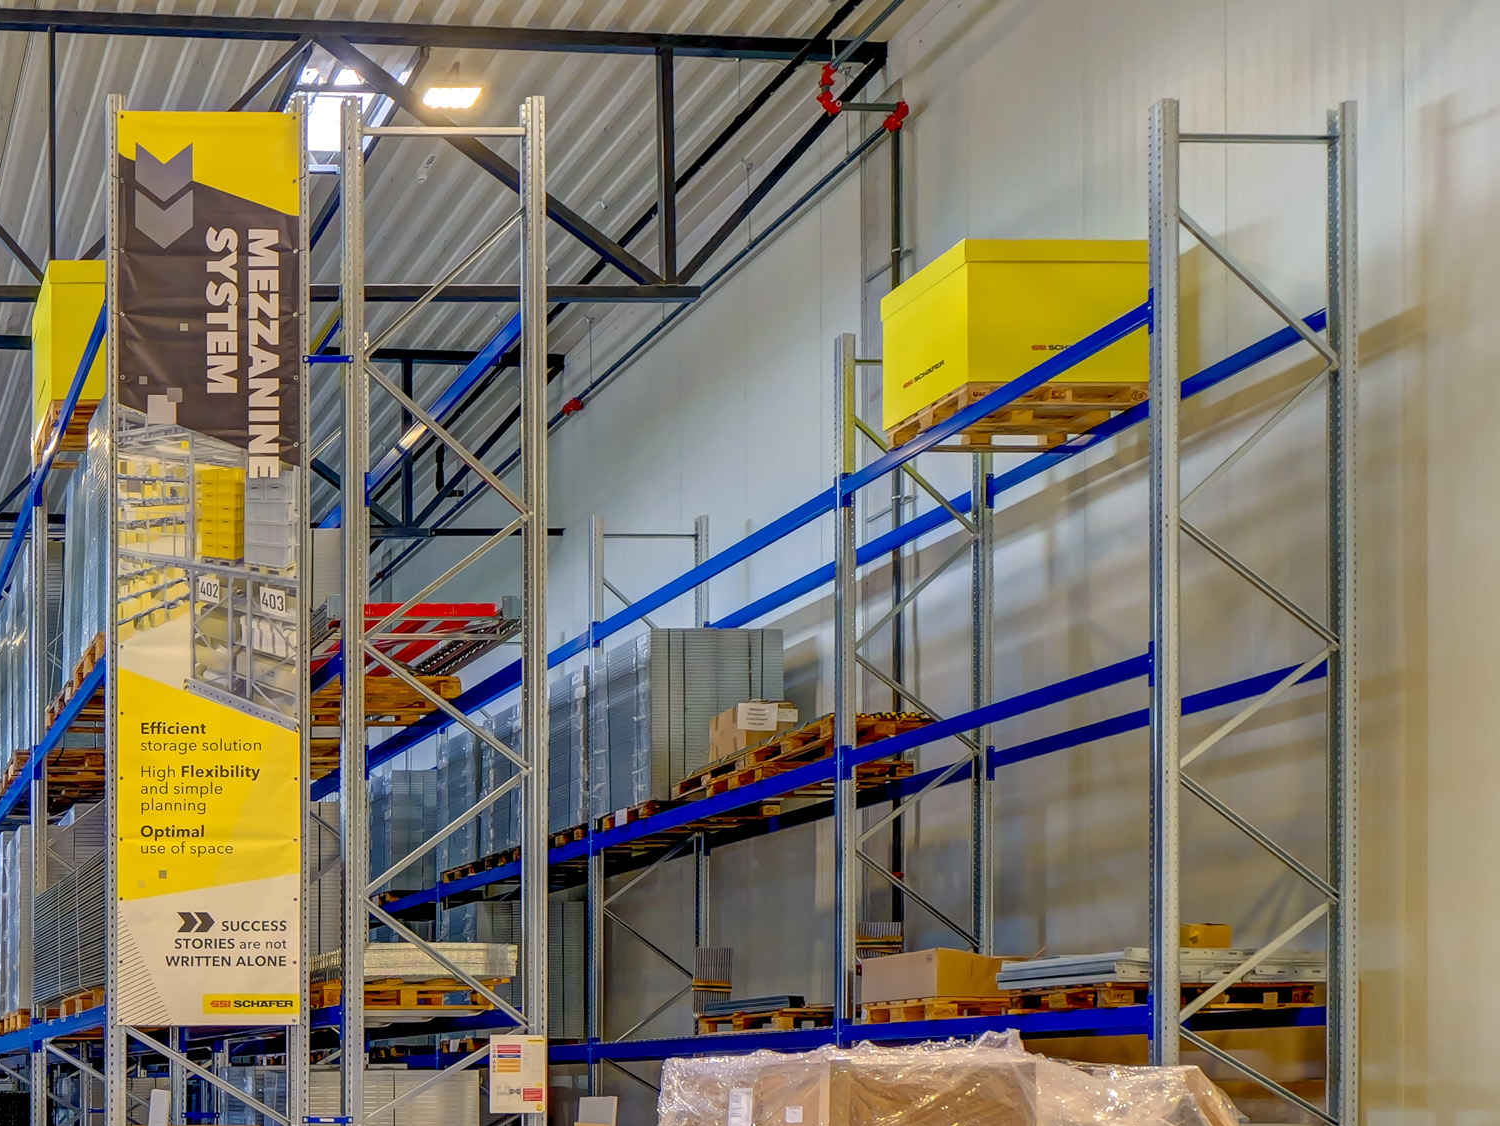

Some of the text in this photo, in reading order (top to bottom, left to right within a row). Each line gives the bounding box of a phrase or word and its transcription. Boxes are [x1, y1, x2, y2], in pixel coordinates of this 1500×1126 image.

[206, 226, 239, 394] SYSTEM
[248, 229, 280, 478] MEZZANINE
[200, 581, 219, 599] 402
[262, 592, 284, 611] 403
[140, 722, 206, 735] Efficient
[140, 738, 262, 755] storage solution
[141, 765, 261, 781] High Flexibility
[140, 782, 223, 798] and simple
[141, 798, 206, 815] planning
[140, 825, 205, 841] Optimal
[140, 841, 234, 858] use of space
[221, 920, 287, 932] SUCCESS
[174, 938, 287, 949] STORIES are not
[165, 955, 287, 967] WRITTEN ALONE
[209, 1000, 231, 1008] SSI
